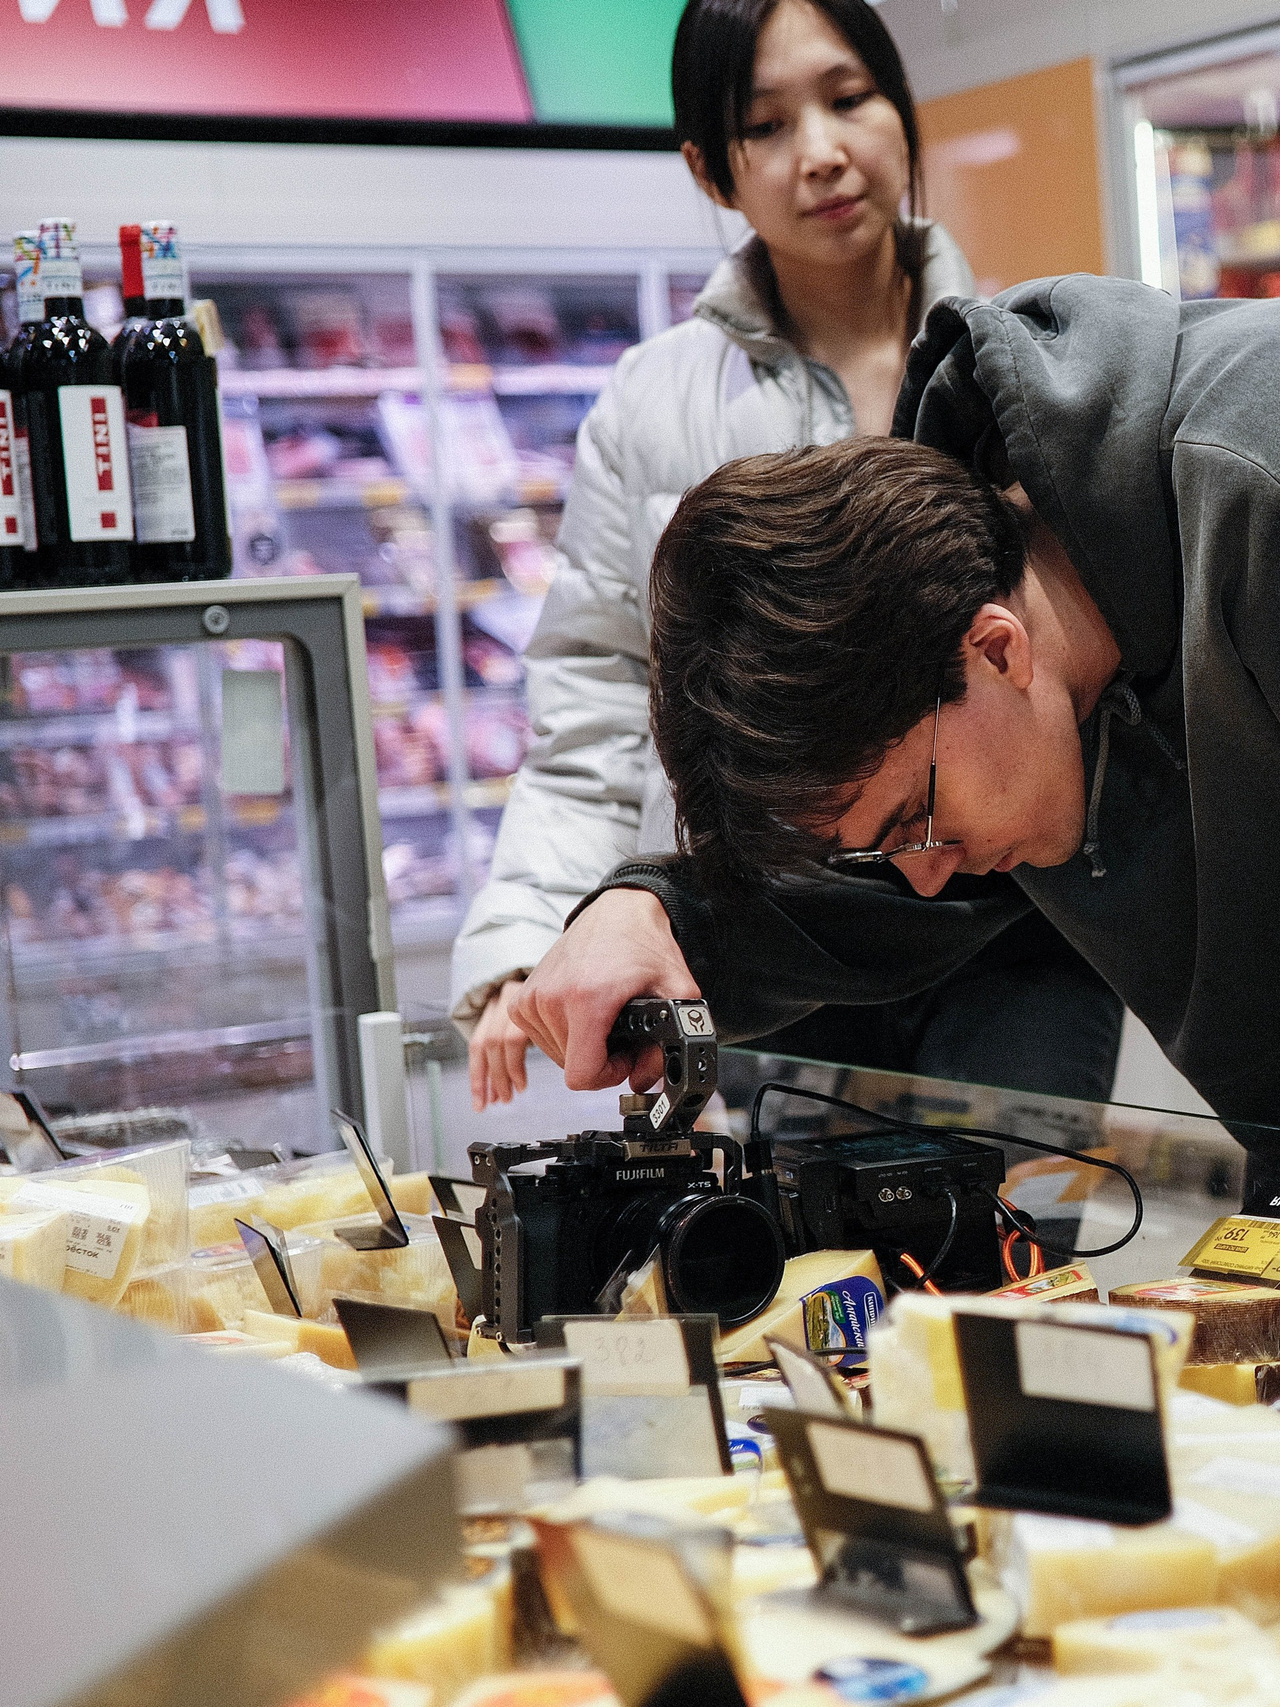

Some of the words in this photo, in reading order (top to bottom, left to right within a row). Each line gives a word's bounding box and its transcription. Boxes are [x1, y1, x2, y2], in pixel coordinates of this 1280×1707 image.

[92, 412, 111, 477] TINI
[616, 1167, 665, 1181] FUJIFILM
[1223, 1228, 1250, 1242] 139
[867, 1295, 876, 1327] КИПРИ
